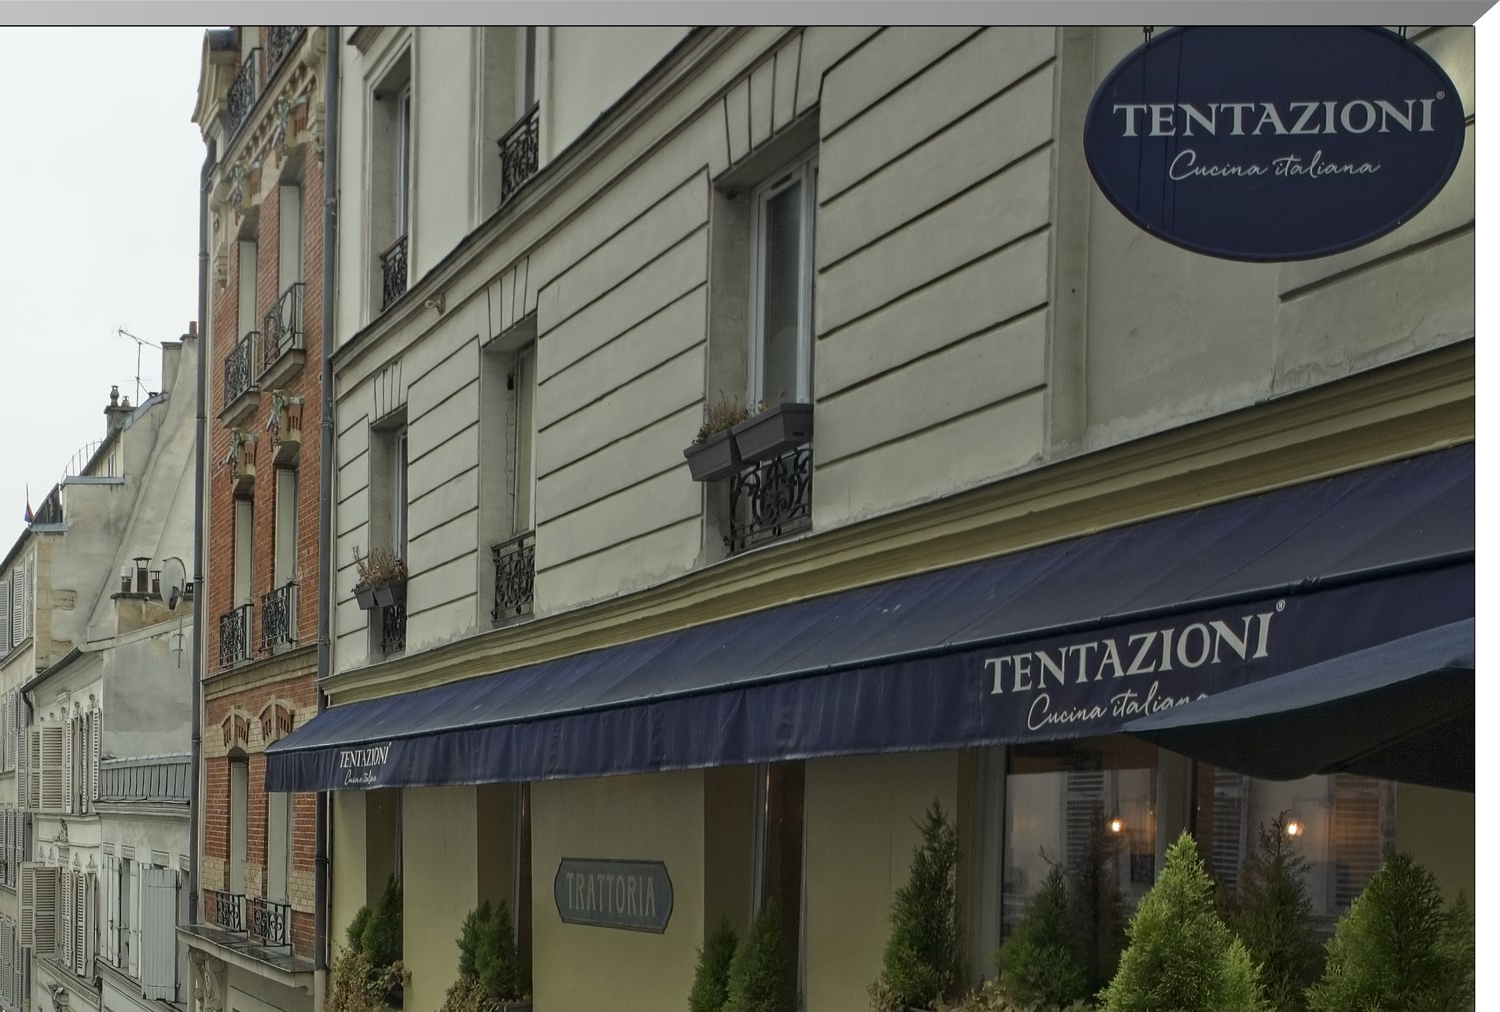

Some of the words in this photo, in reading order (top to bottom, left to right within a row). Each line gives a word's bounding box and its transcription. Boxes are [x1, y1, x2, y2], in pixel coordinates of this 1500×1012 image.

[1169, 149, 1268, 181] Cucina
[1272, 150, 1381, 180] italiana
[1027, 692, 1108, 731] Cucina
[566, 872, 656, 917] TRATTORIA
